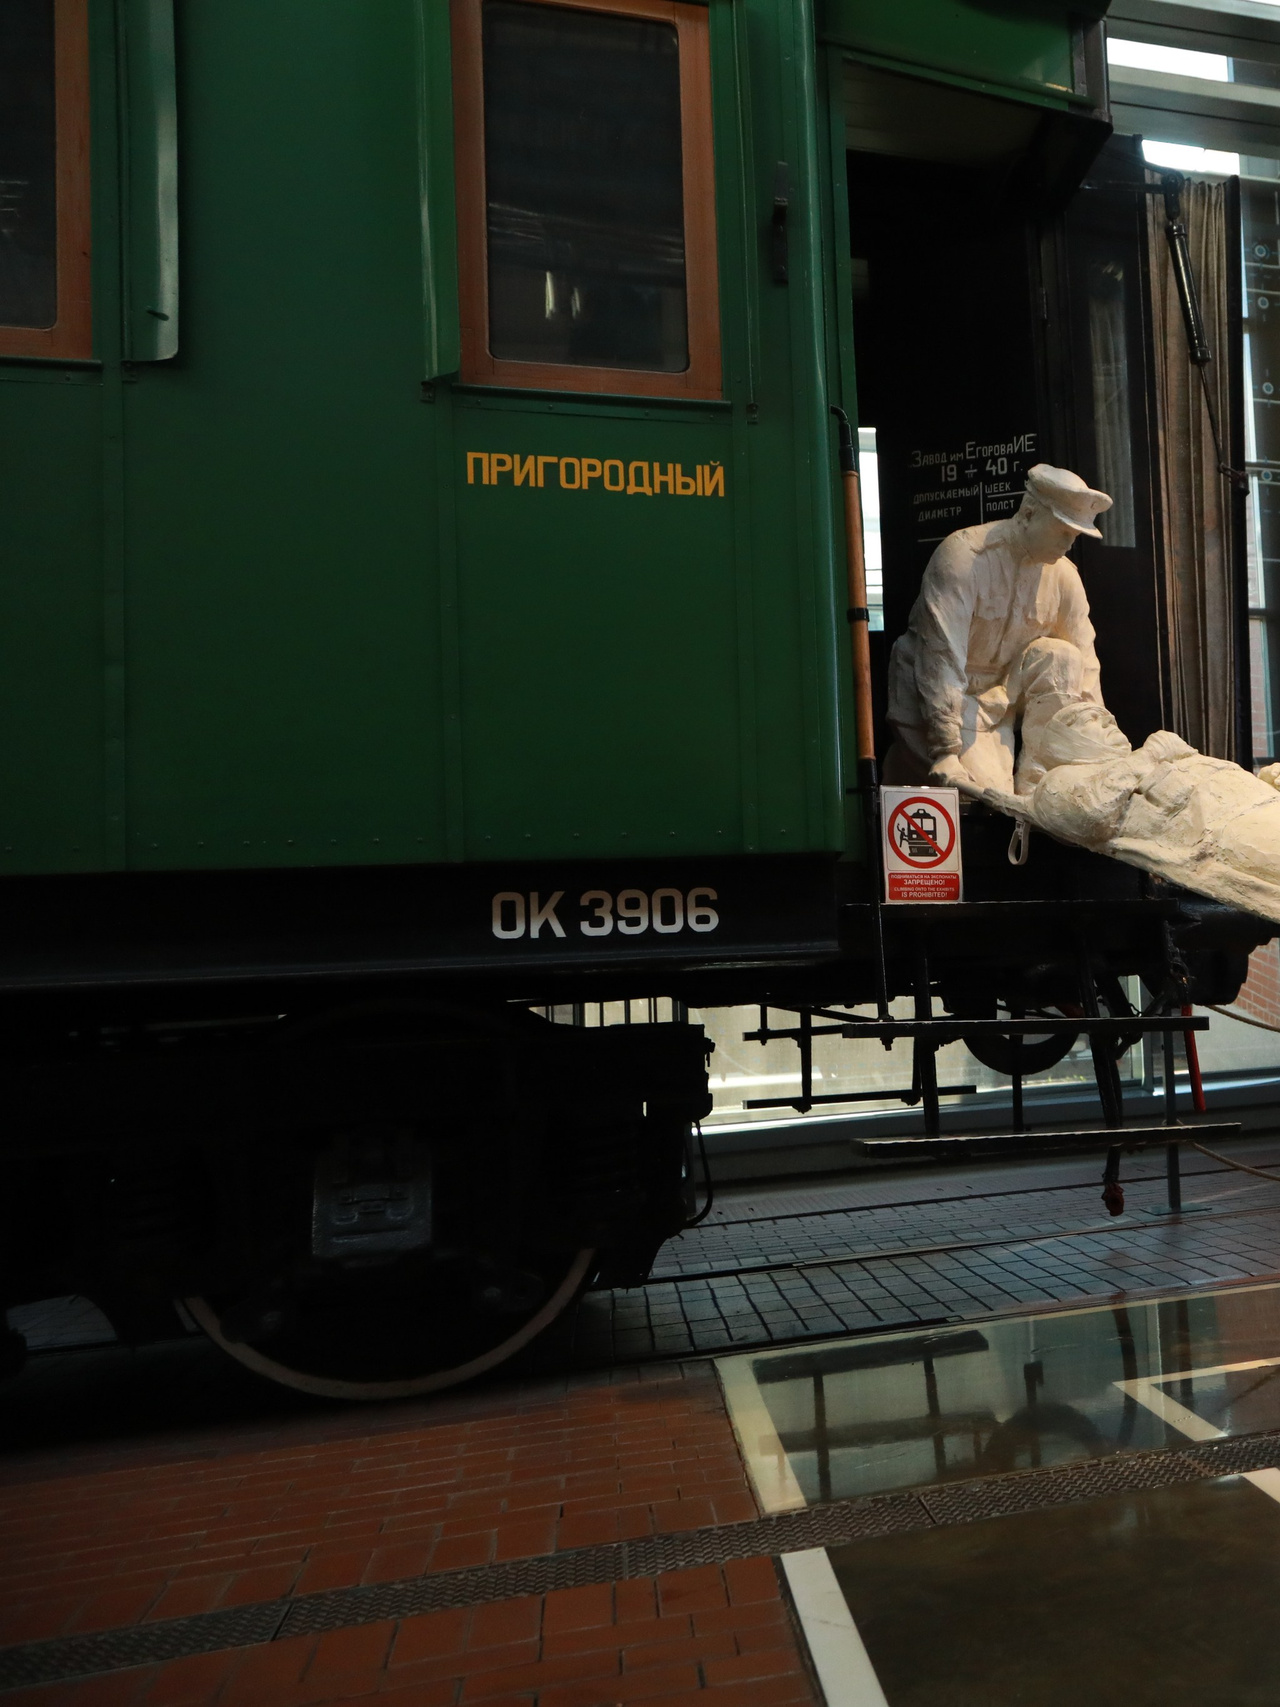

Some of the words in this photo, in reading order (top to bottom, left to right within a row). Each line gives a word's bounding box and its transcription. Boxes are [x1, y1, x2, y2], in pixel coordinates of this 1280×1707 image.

[467, 452, 725, 497] ПРИГОРОДНЫЙ
[941, 464, 957, 483] 19
[985, 457, 1008, 476] 40
[918, 506, 962, 522] ДИАМЕТР
[492, 891, 567, 939] ОК
[580, 887, 720, 936] 3906
